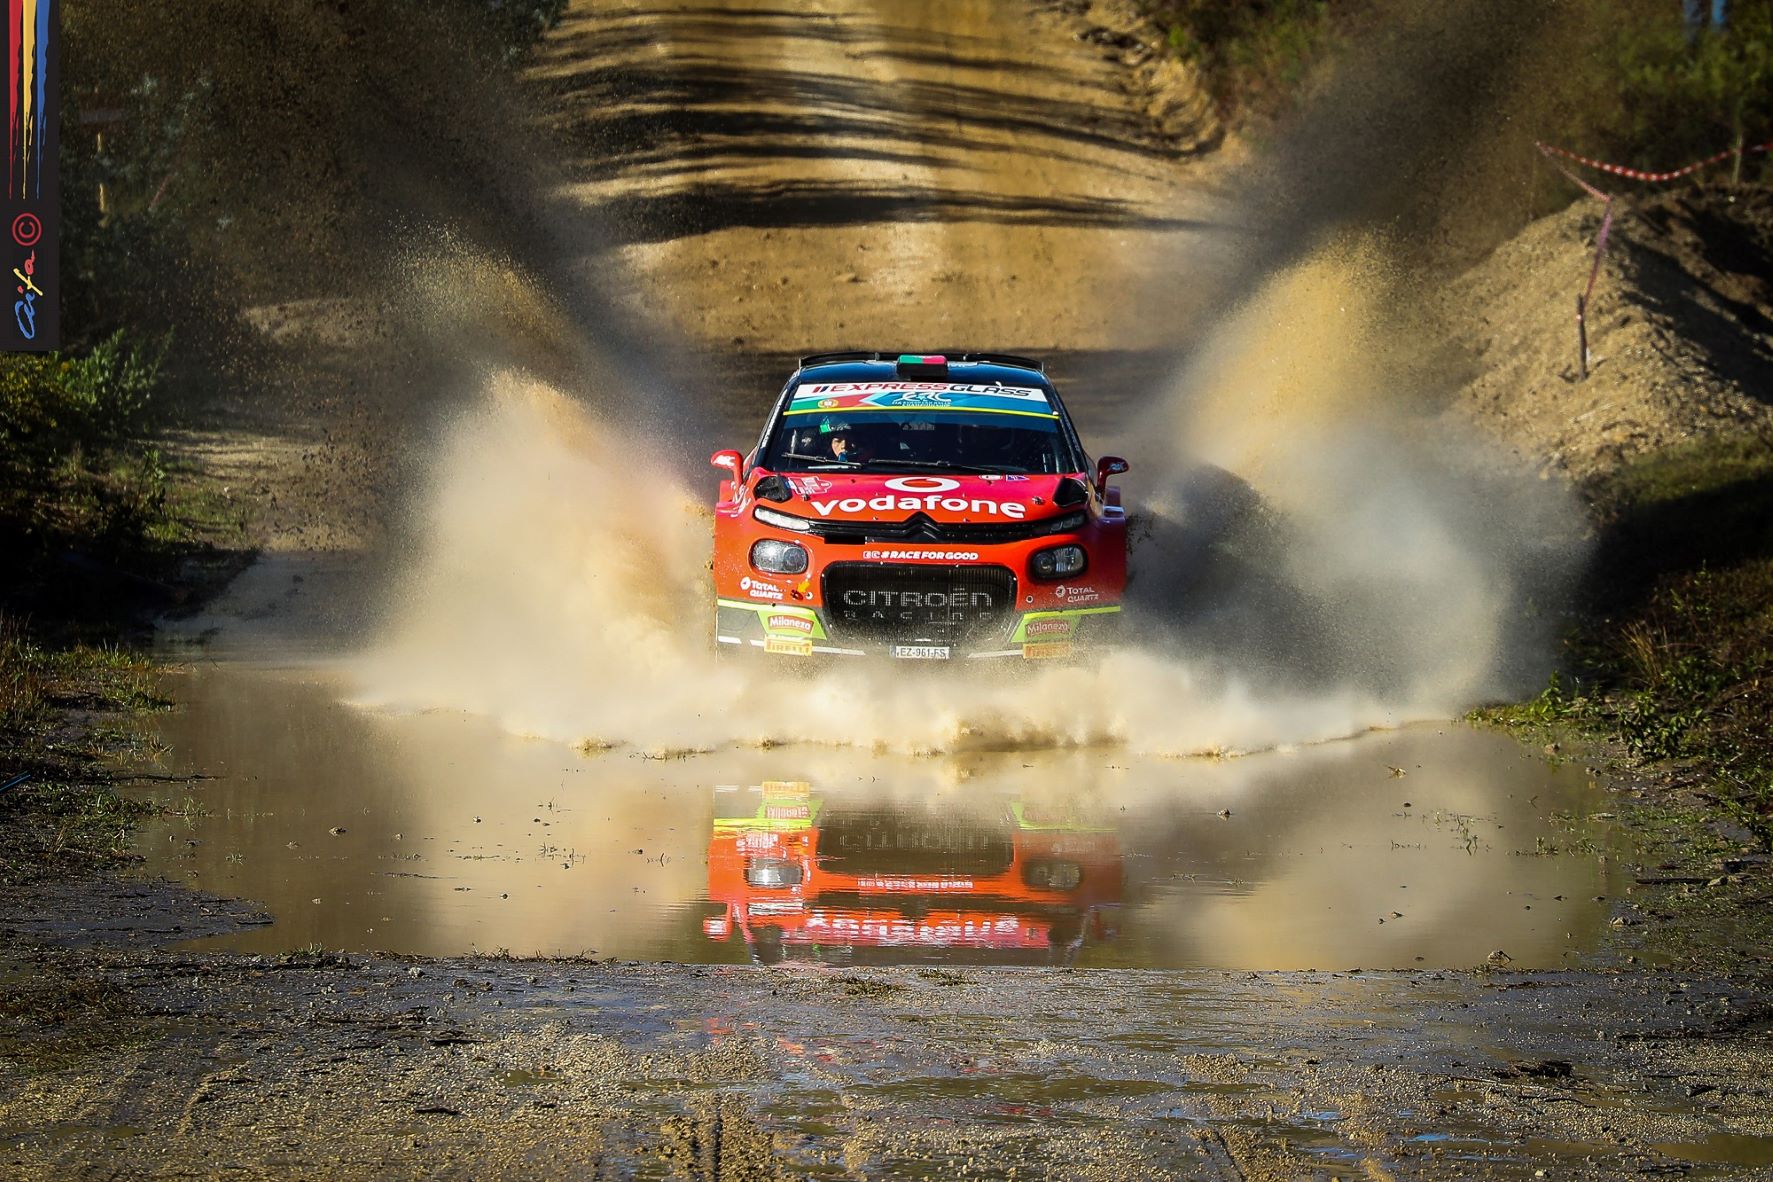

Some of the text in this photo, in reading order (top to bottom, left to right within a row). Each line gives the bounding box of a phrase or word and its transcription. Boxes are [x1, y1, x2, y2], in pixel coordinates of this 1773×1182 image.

[830, 382, 1032, 397] EXPRESSGLASS
[810, 494, 1026, 519] vodafone
[749, 590, 784, 600] QUARTZ
[1066, 587, 1095, 595] TOTAL
